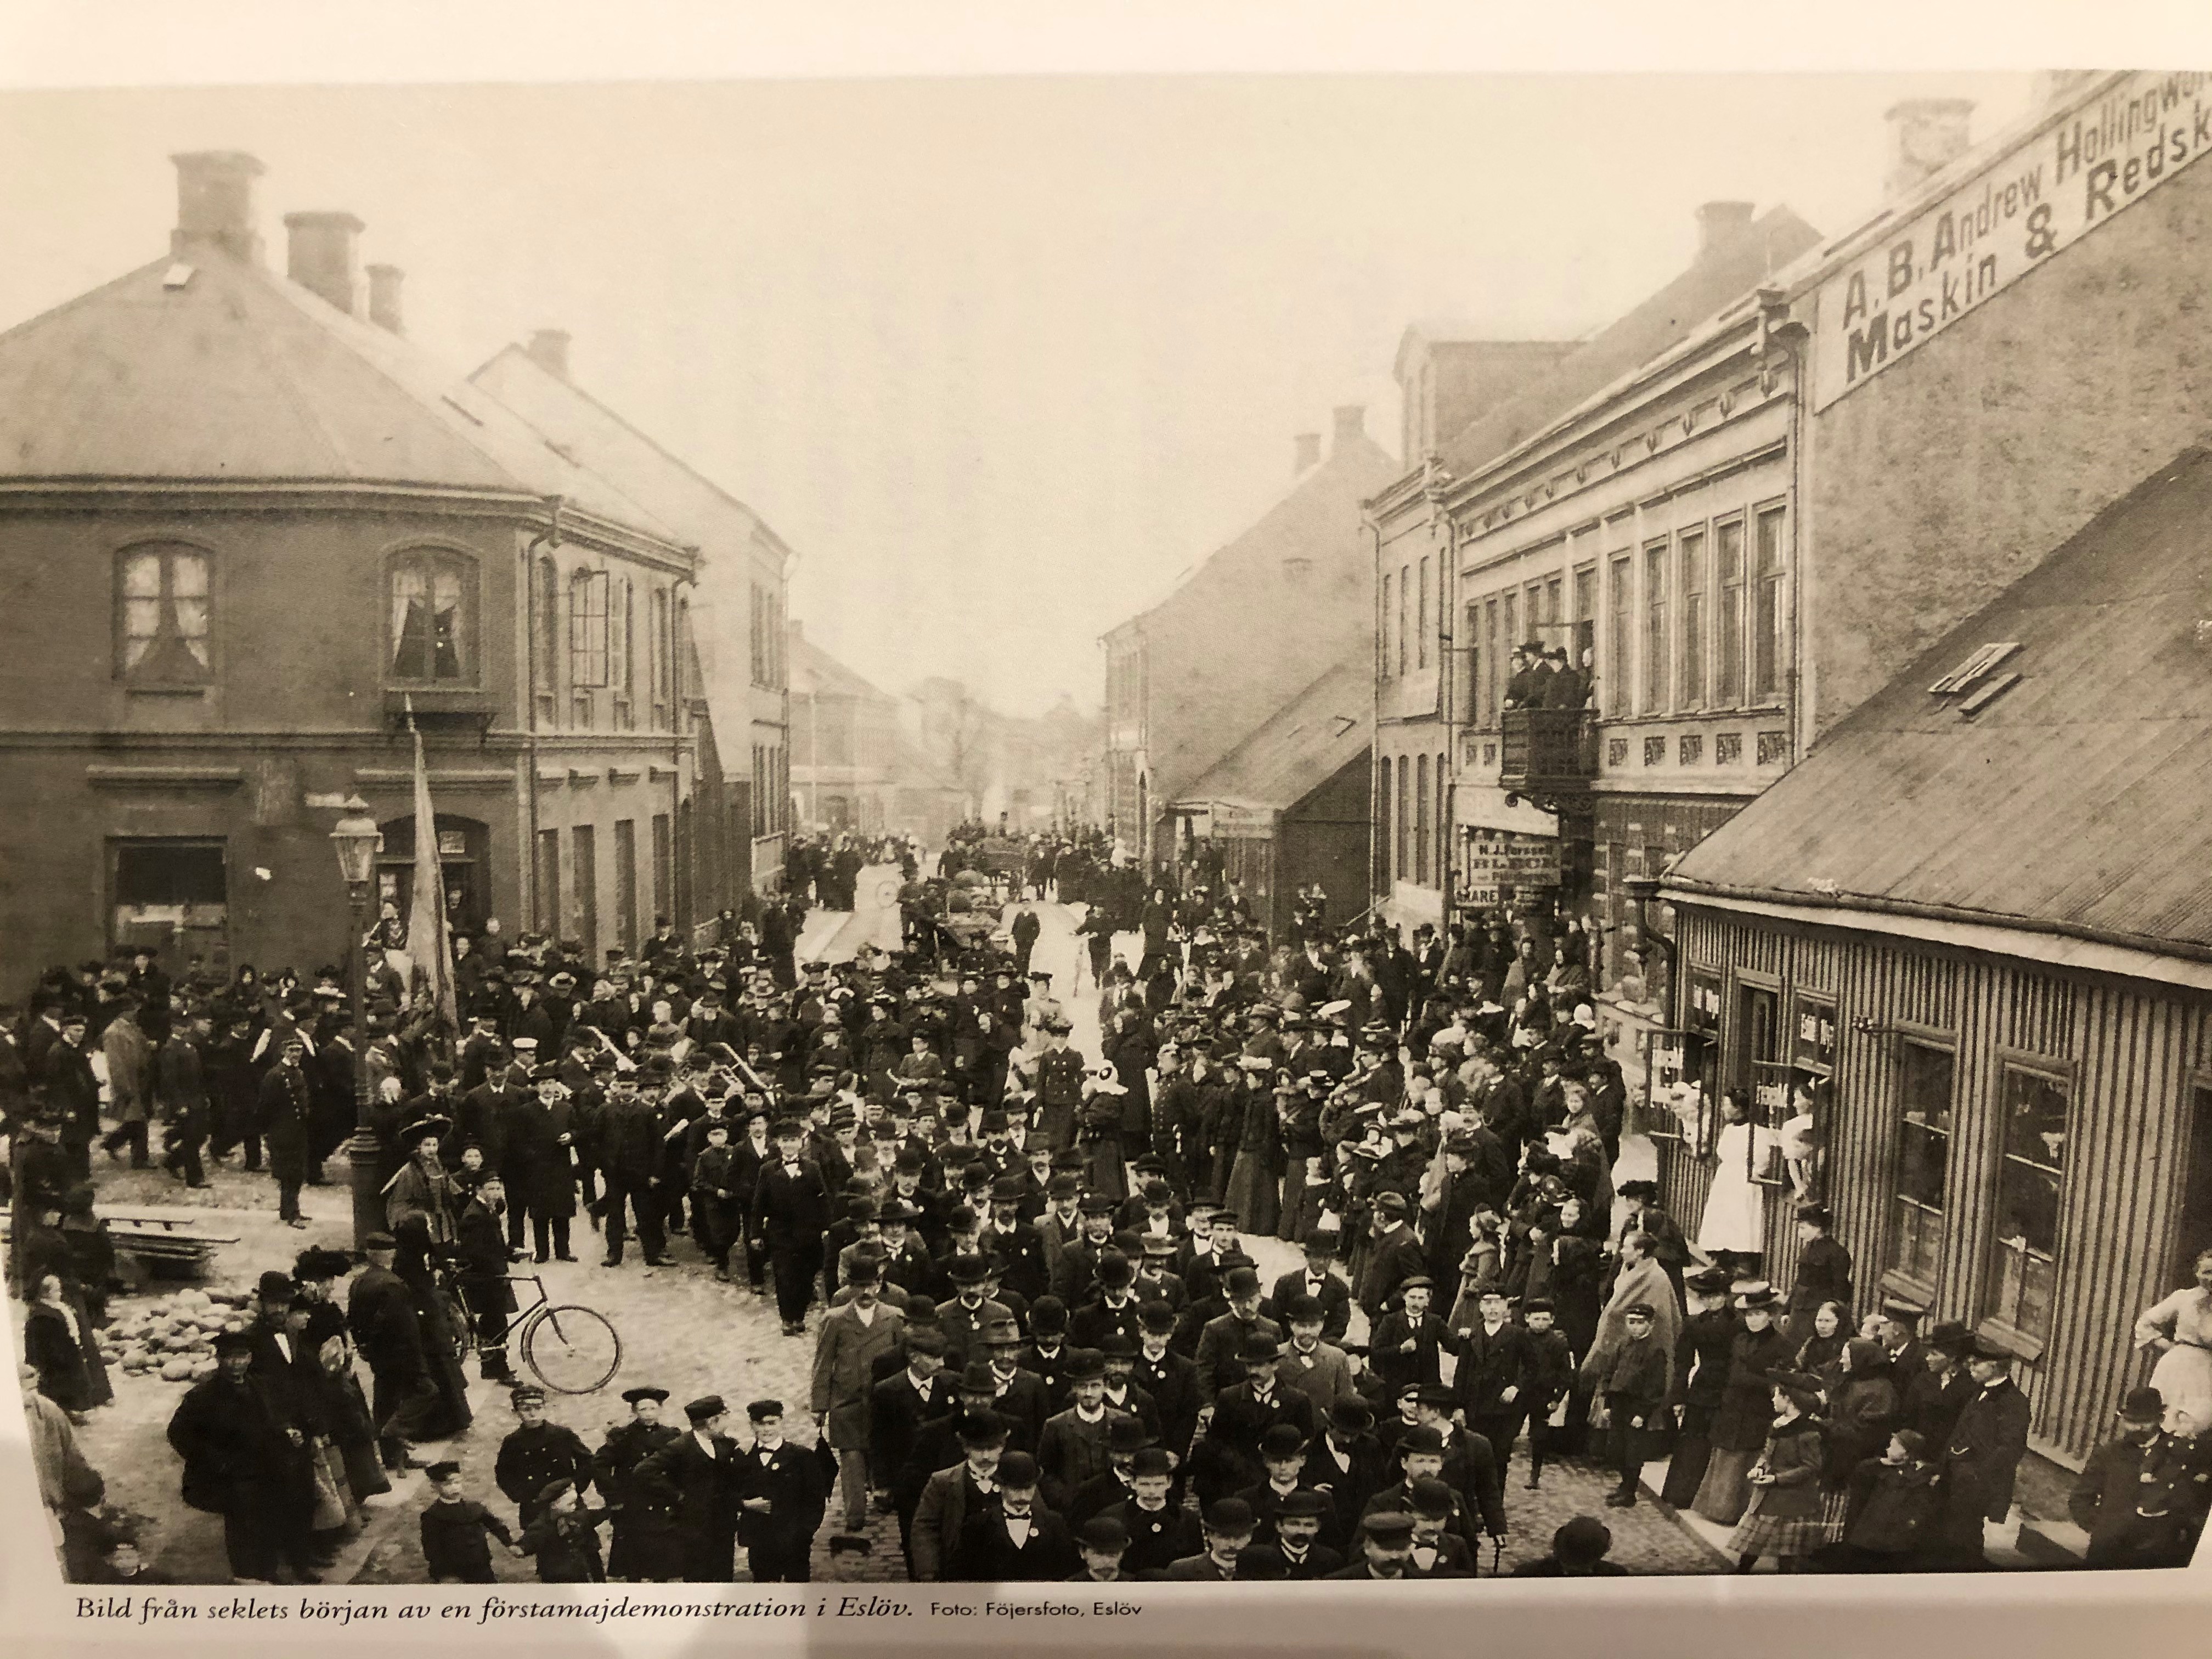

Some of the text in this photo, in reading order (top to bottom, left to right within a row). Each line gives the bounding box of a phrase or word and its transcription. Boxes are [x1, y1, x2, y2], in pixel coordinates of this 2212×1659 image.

[1846, 99, 2212, 382] Maskin & Redsk
[1930, 165, 2042, 273] Andrew
[76, 1595, 1143, 1626] Bild från seklets början av en förstamajdemonstration i Eslöv. Foto: Föjersfoto, Eslöv
